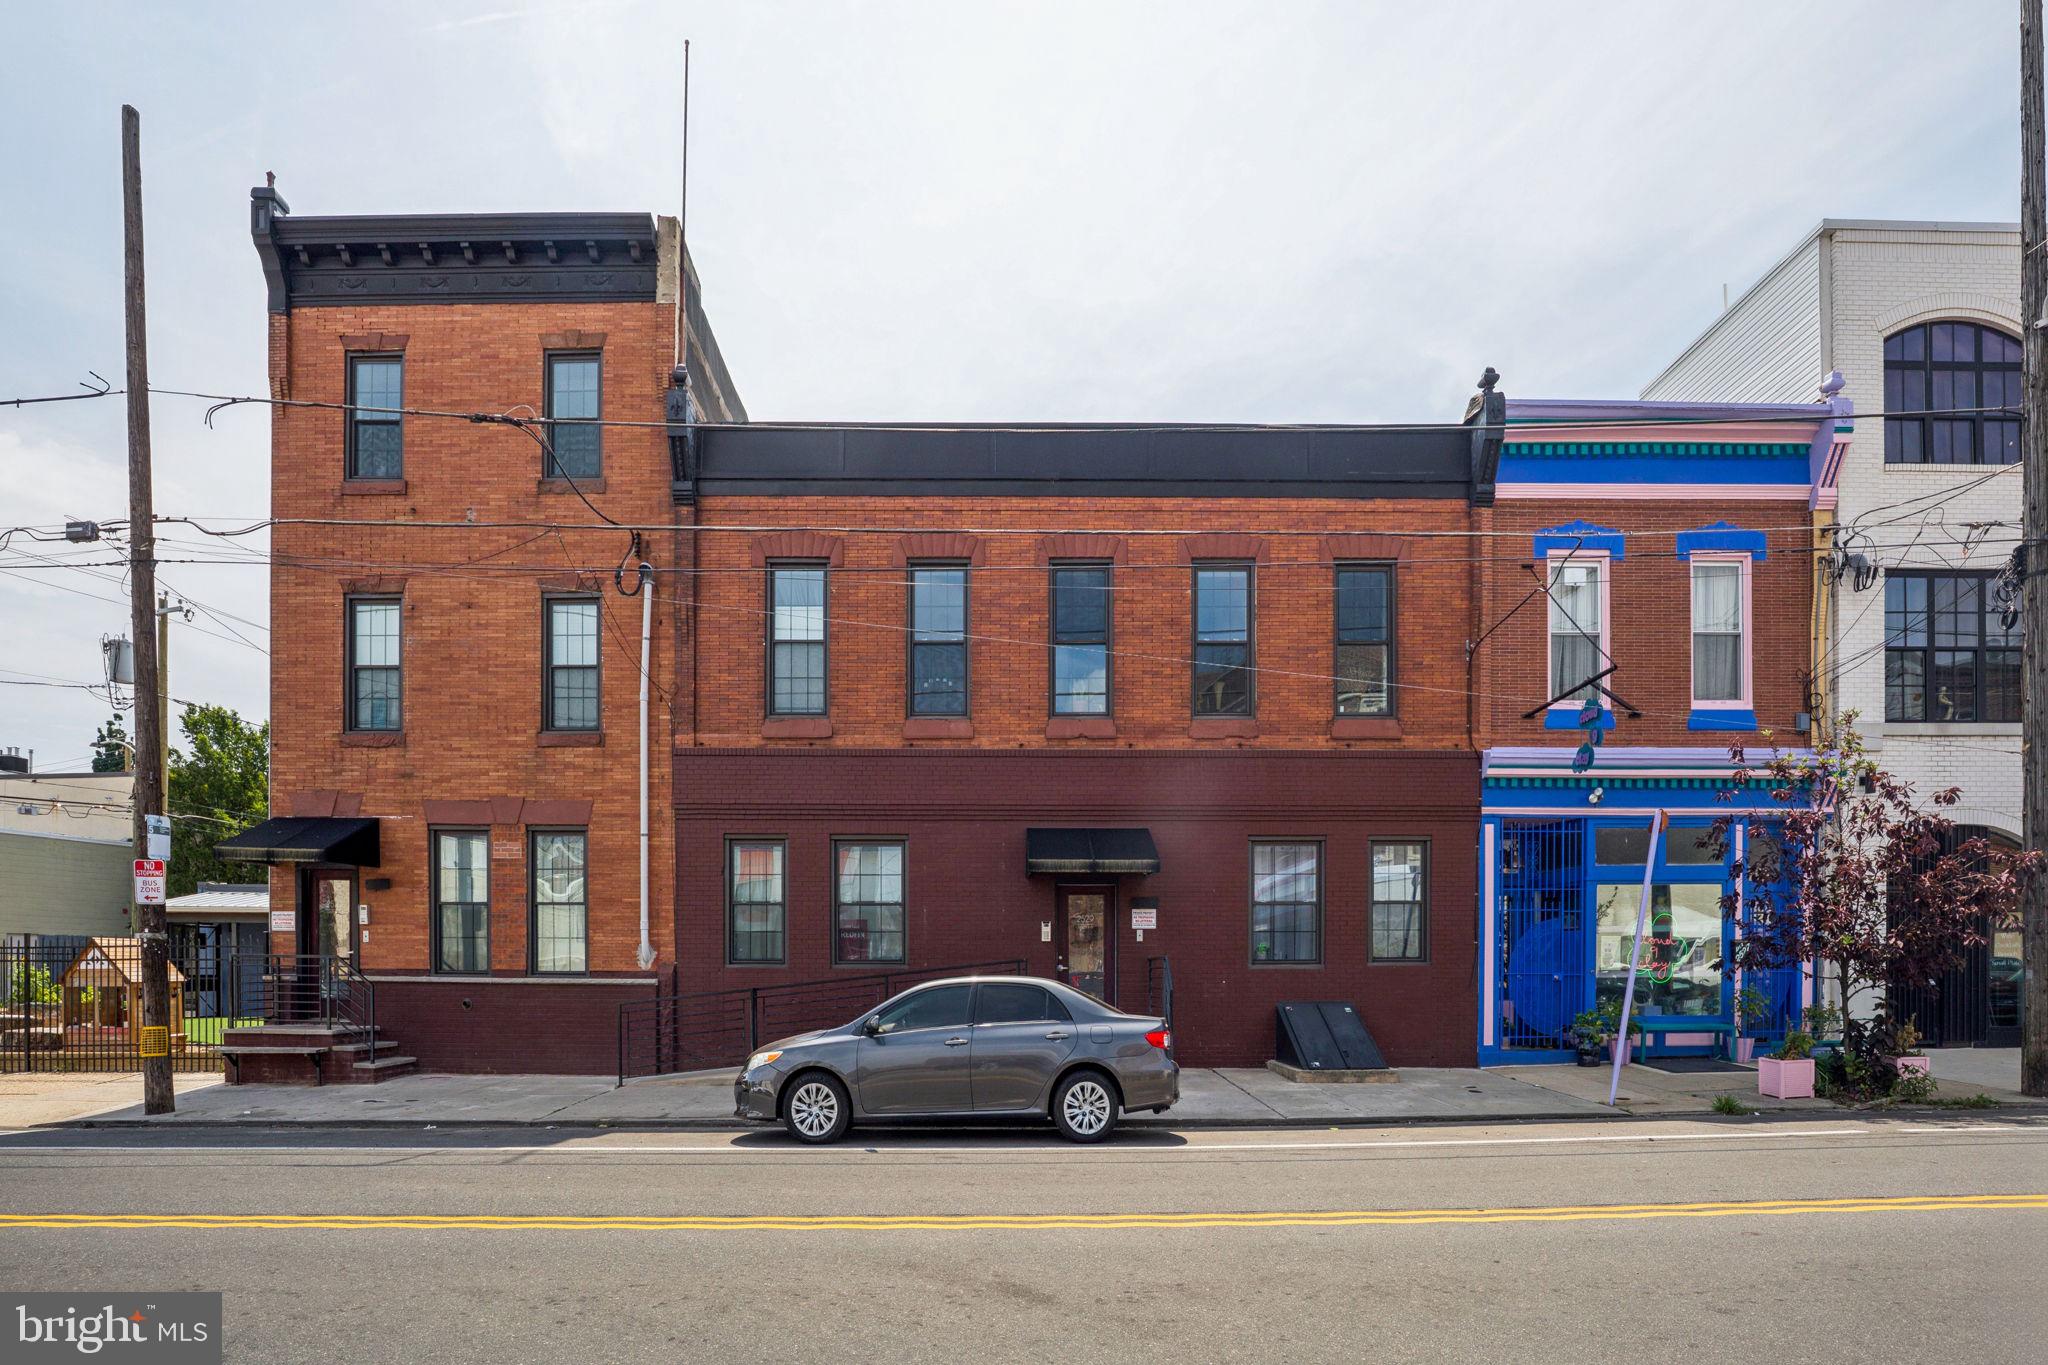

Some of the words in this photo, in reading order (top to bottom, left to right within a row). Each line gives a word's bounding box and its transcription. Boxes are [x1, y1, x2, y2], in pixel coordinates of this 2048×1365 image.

[144, 862, 155, 870] NO
[1641, 932, 1677, 945] loud
[1638, 954, 1671, 979] clay
